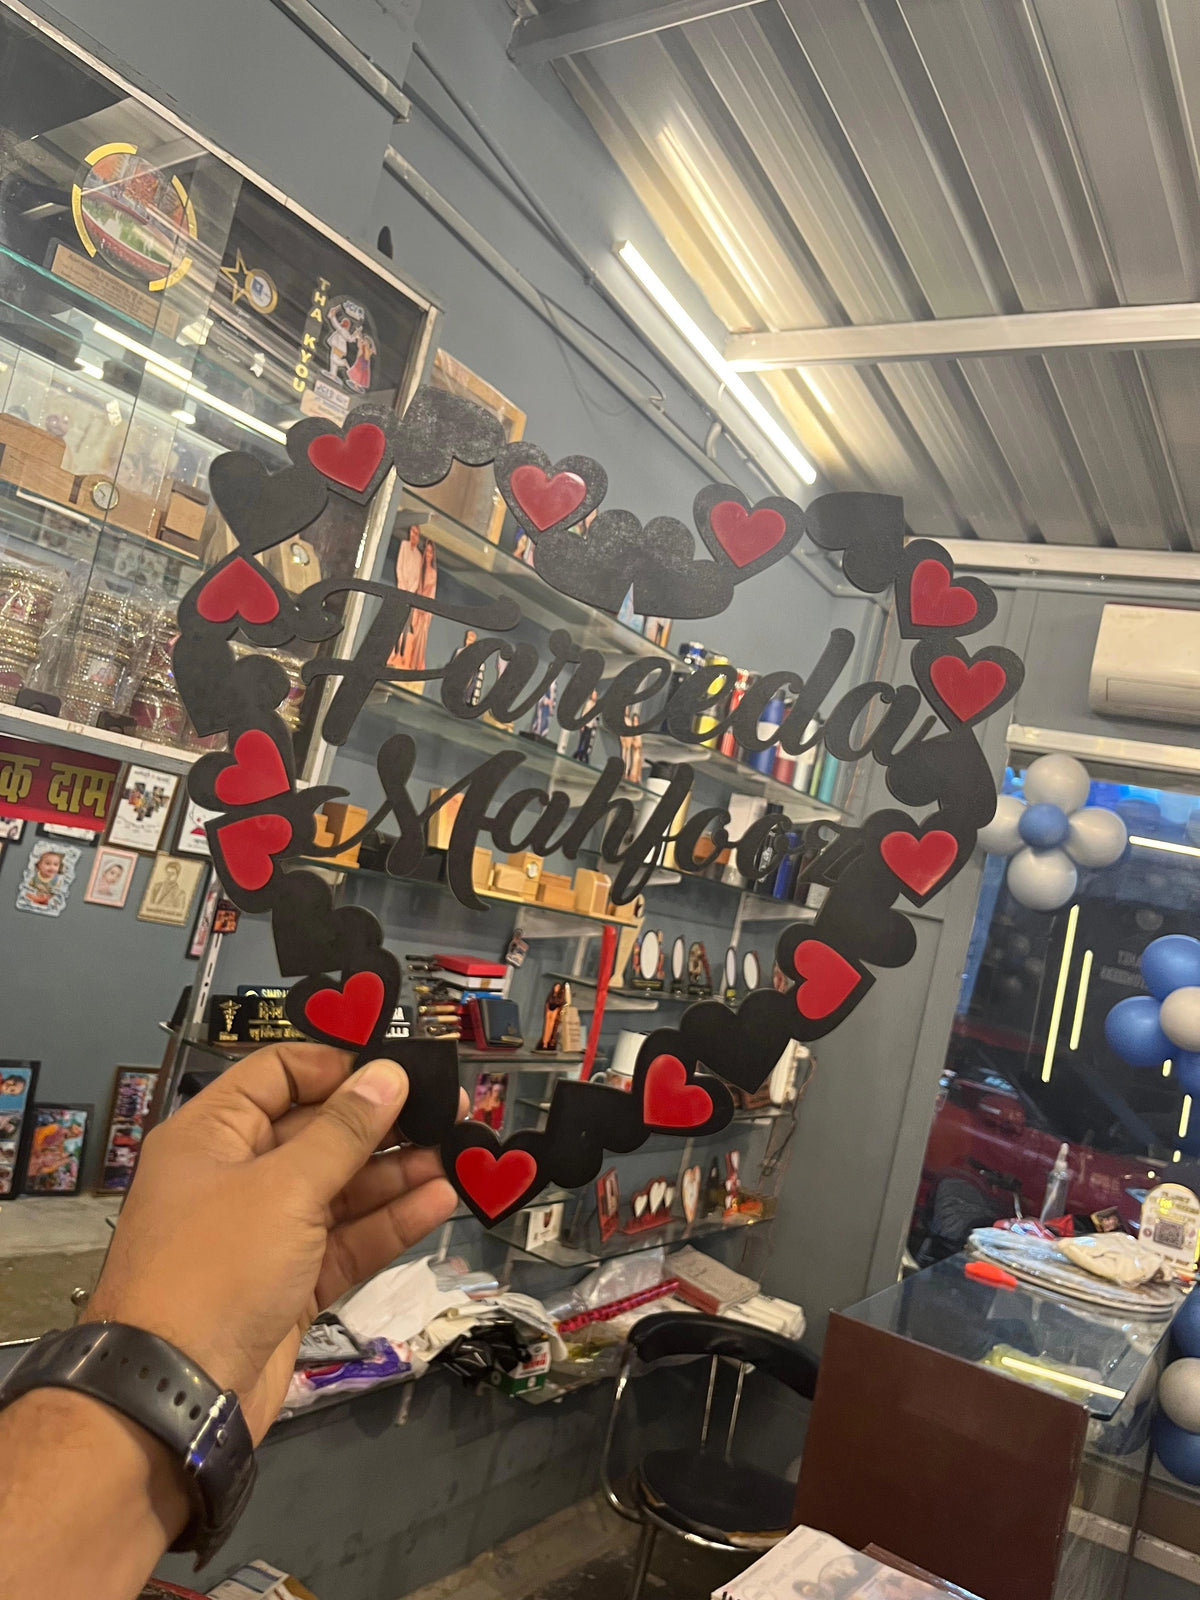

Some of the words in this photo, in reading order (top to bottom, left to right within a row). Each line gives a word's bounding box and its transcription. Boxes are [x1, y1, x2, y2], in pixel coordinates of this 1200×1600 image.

[299, 578, 937, 767] Fareeda
[0, 752, 41, 804] क
[48, 761, 116, 818] दाम
[303, 733, 862, 912] Mahfooz
